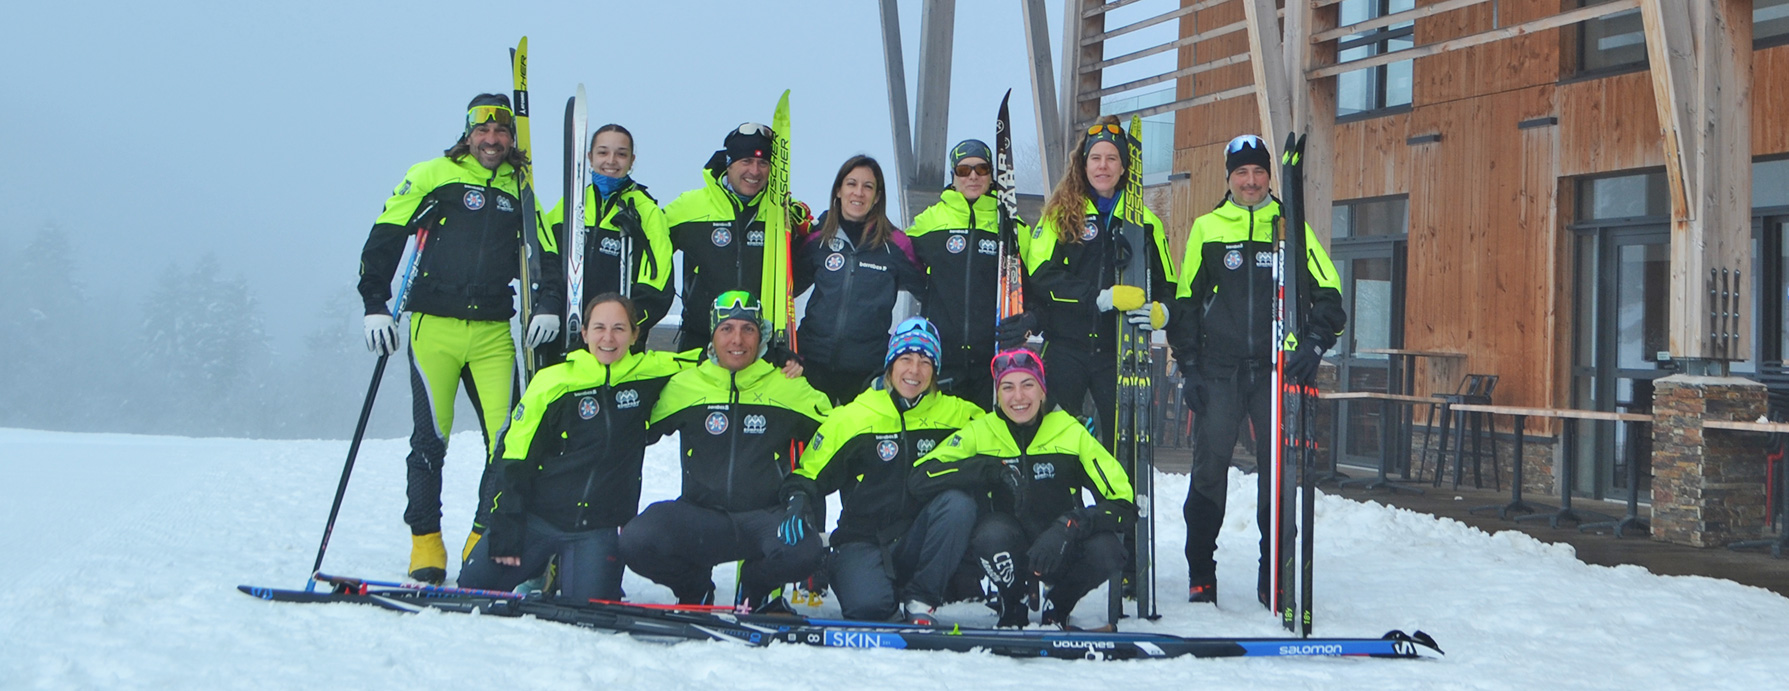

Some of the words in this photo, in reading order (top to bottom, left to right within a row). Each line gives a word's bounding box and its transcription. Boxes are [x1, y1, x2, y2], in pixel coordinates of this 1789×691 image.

[770, 130, 779, 206] FISCHER
[780, 138, 789, 207] FISCHER
[1125, 142, 1135, 224] FISCHER
[1134, 147, 1143, 228] FISCHER
[833, 632, 881, 648] SKIN
[1279, 644, 1343, 655] salomon
